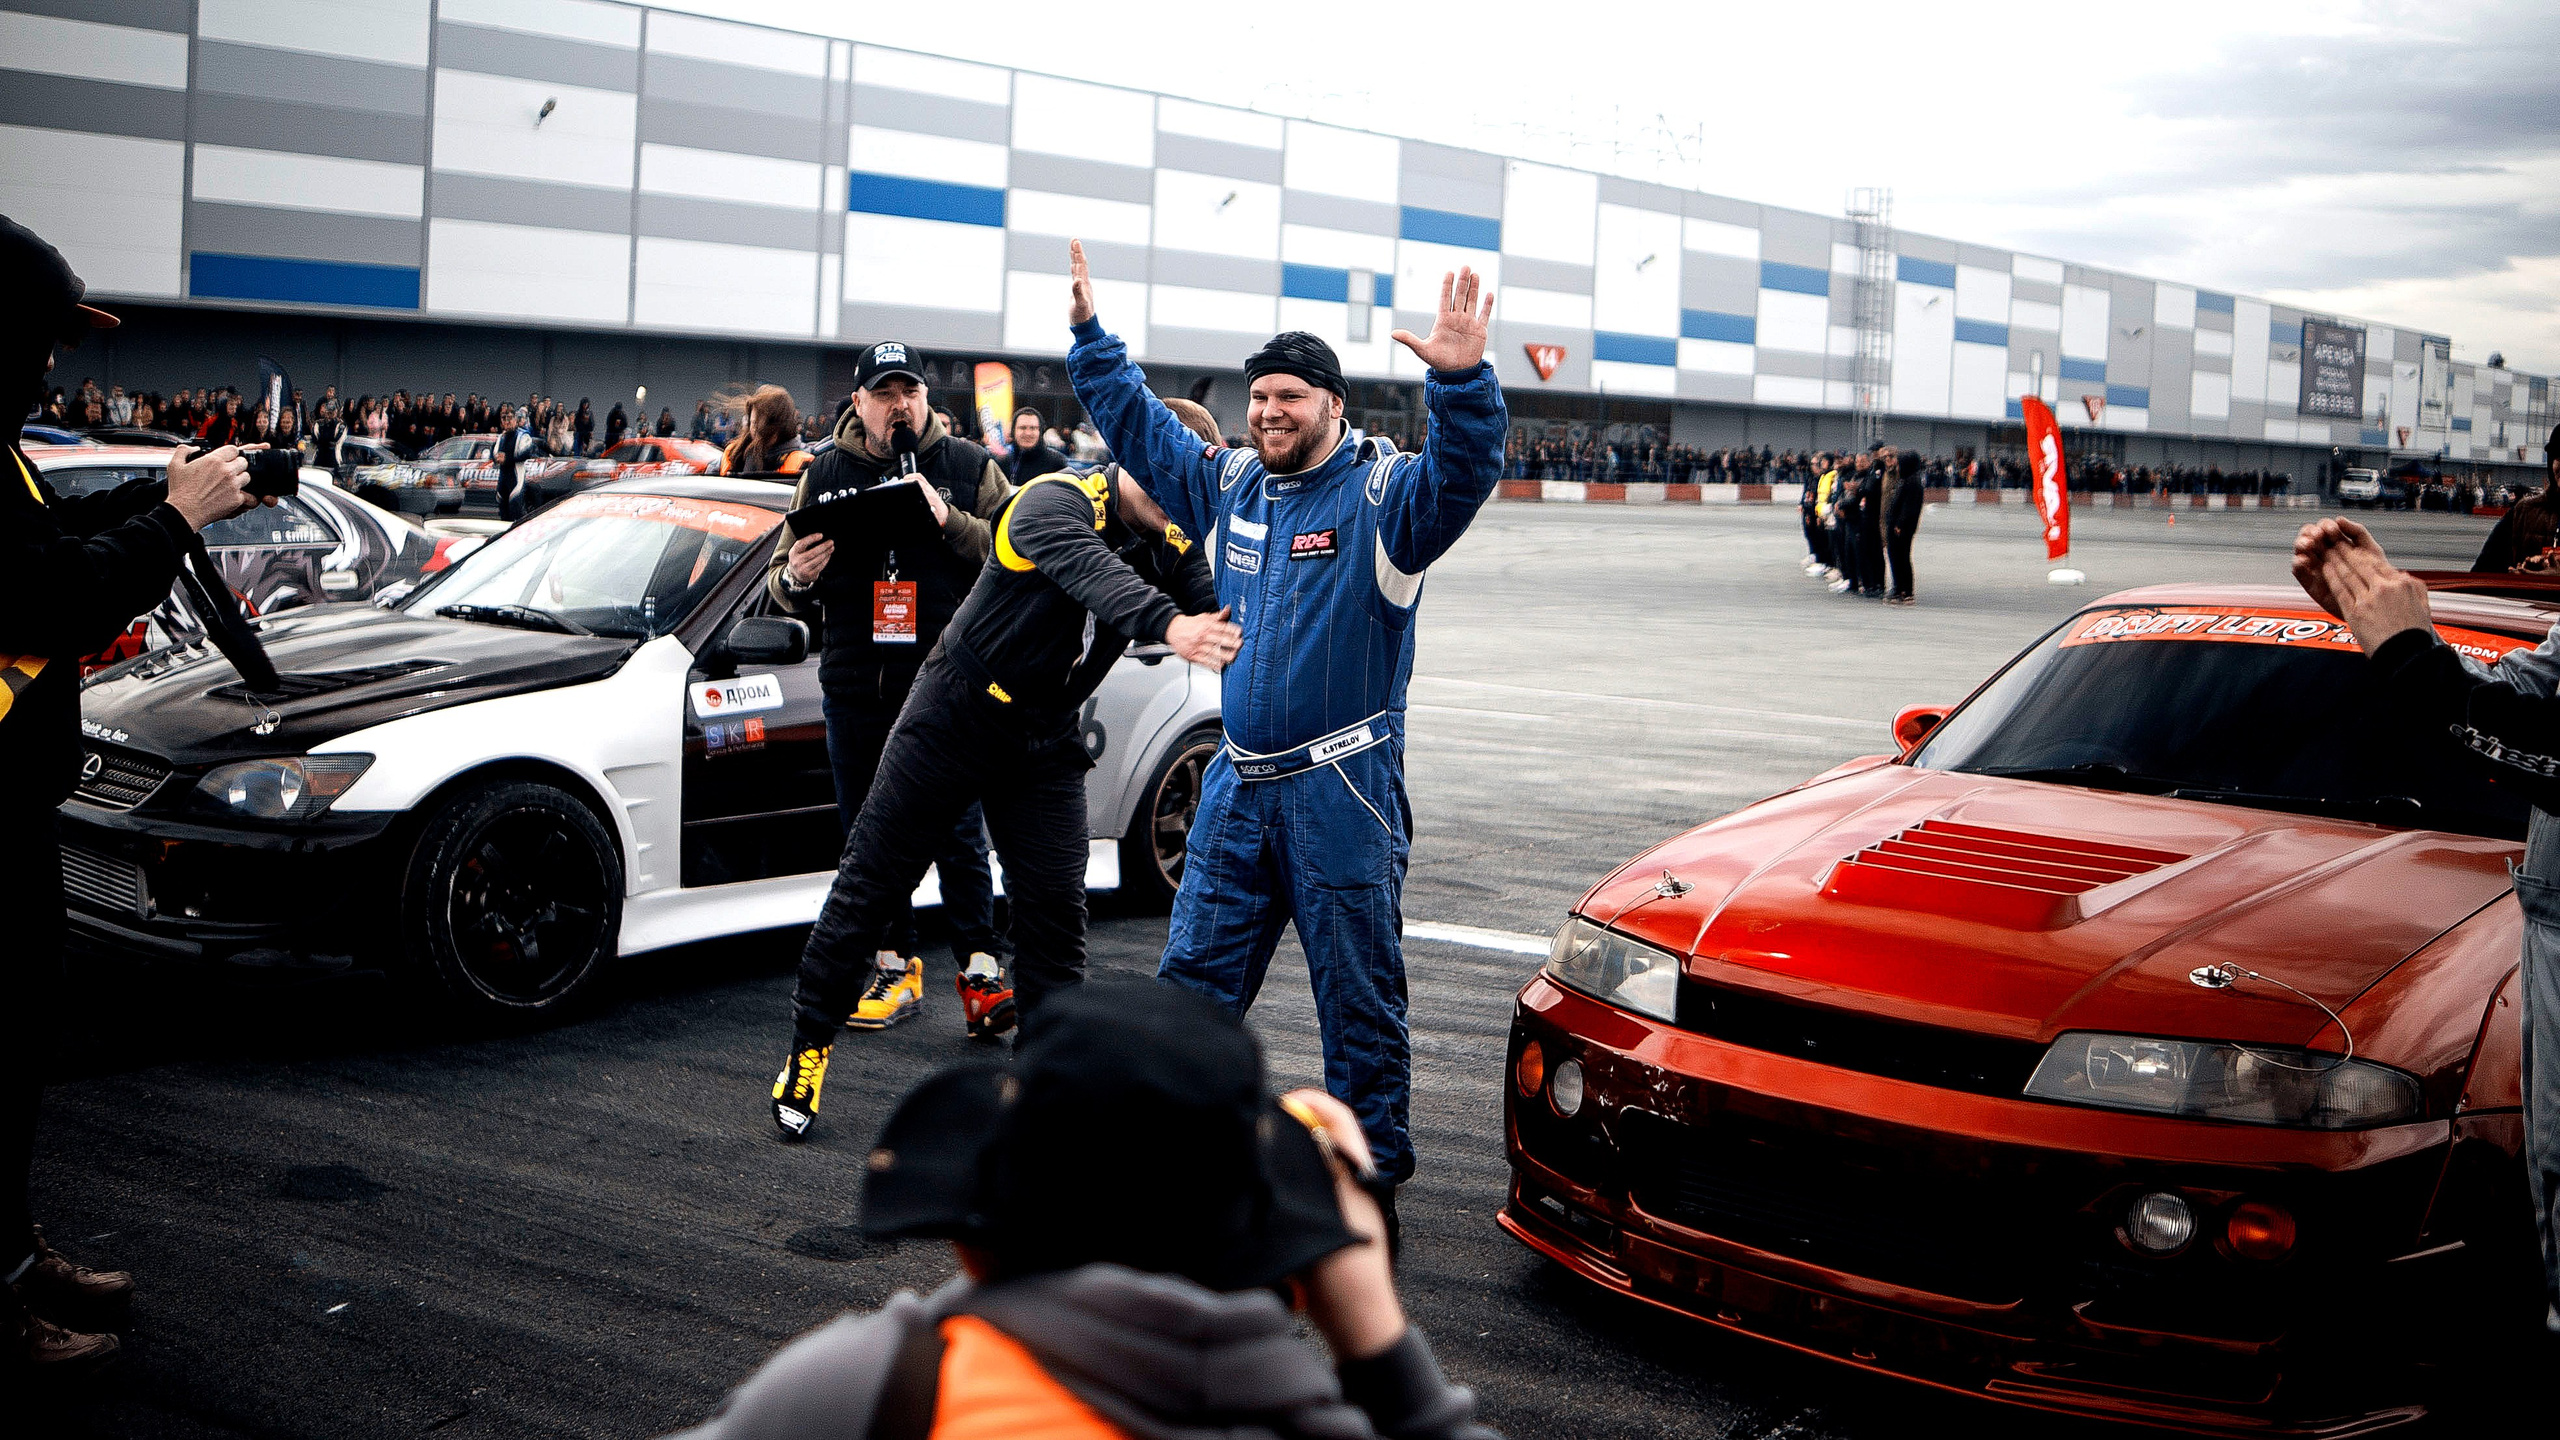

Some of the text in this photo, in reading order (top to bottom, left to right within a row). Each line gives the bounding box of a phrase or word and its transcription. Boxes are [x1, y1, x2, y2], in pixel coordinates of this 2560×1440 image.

[874, 343, 905, 354] STR
[875, 352, 907, 366] KER
[1536, 347, 1557, 368] 14
[1291, 531, 1334, 551] RDS
[2078, 614, 2220, 639] DRIFT
[2206, 614, 2329, 641] LETO
[726, 684, 770, 706] дром
[986, 680, 1013, 703] OMP
[708, 719, 761, 746] SKR
[1321, 734, 1360, 756] K.STRELOV
[1239, 764, 1277, 775] sparco
